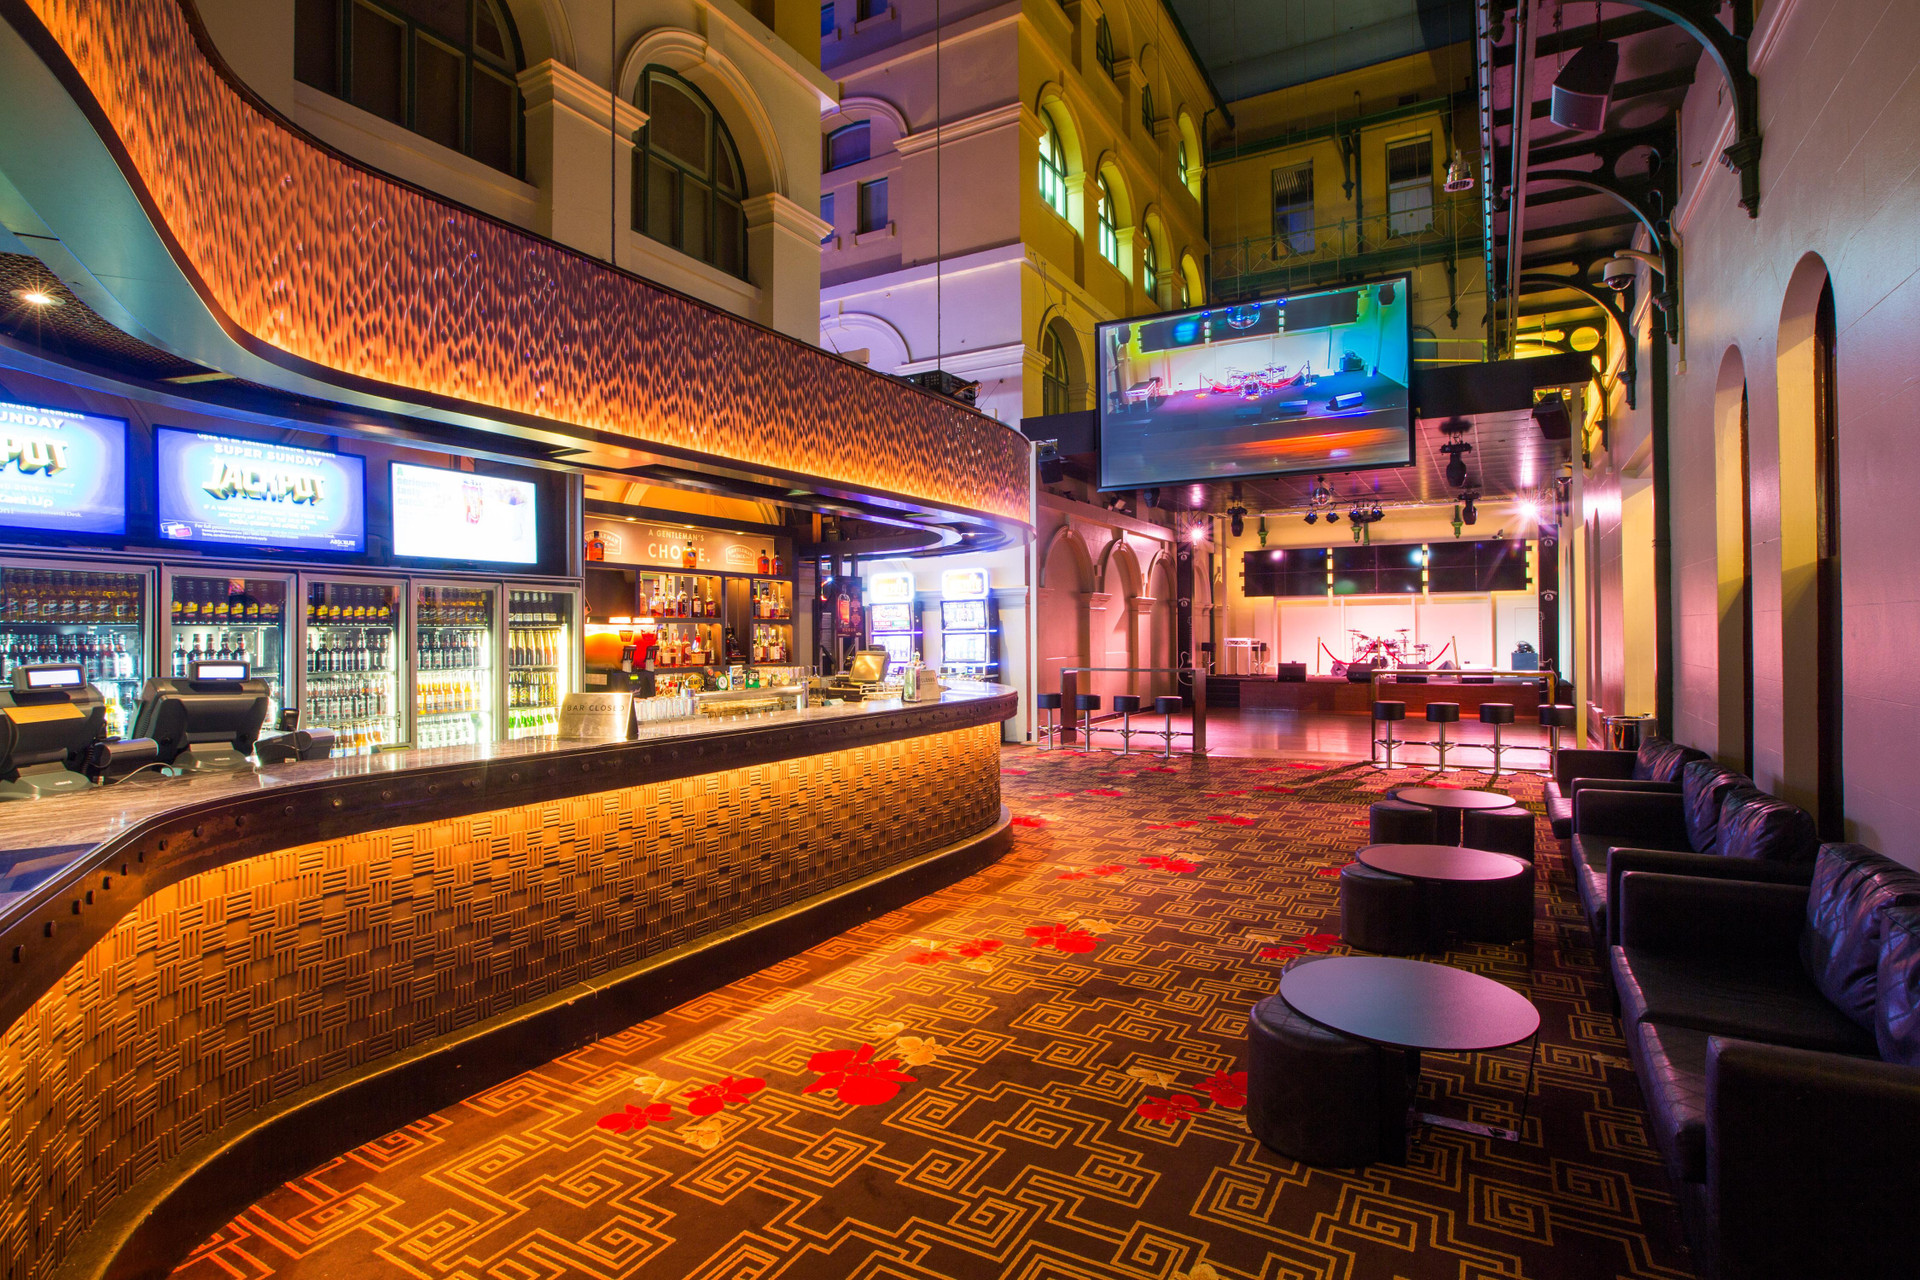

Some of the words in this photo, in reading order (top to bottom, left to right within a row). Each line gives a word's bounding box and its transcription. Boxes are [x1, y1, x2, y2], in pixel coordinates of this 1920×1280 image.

[213, 443, 263, 459] SUPER
[267, 451, 322, 467] SUNDAY
[202, 456, 325, 506] JACKPOT
[648, 529, 654, 537] A
[656, 530, 705, 542] GENTLEMAN'S
[648, 542, 711, 563] CHOE.
[567, 704, 585, 712] BAR
